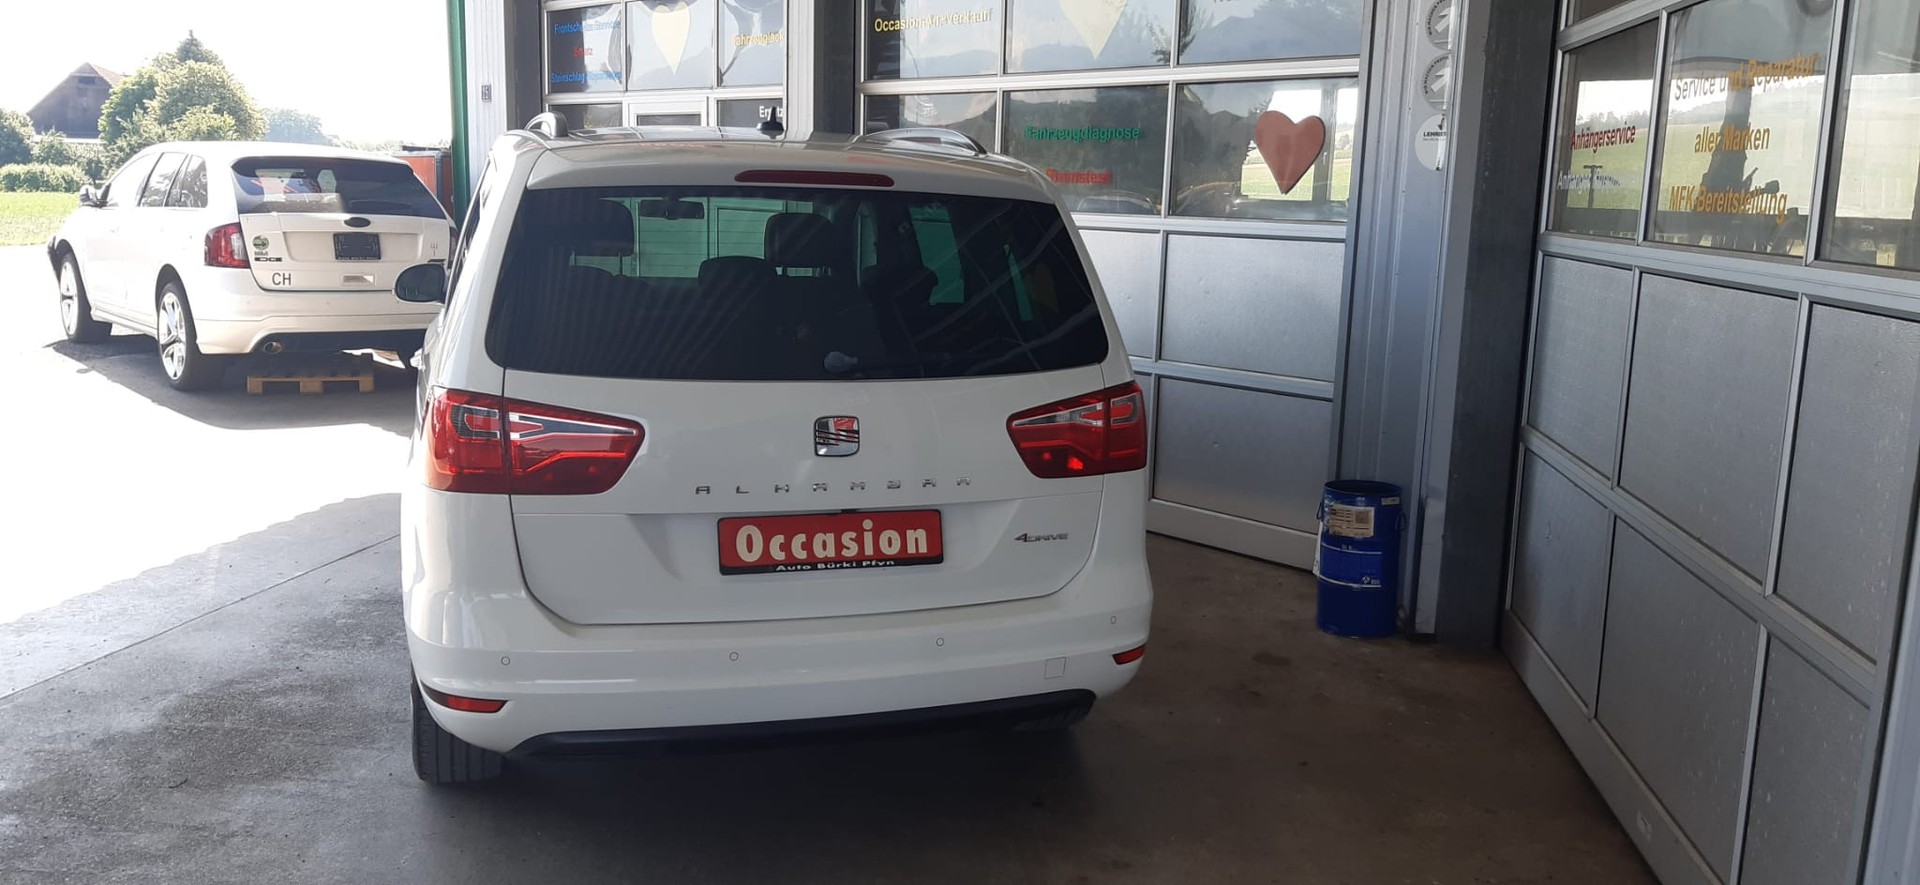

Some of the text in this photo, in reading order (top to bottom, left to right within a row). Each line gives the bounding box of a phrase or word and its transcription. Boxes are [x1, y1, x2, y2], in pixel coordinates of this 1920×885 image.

[1675, 75, 1716, 100] Service
[1748, 53, 1818, 93] Reparatur
[1024, 124, 1140, 143] Fahrzeugdiagnose
[1570, 121, 1636, 153] Anhängerservice
[1695, 122, 1770, 153] aller Marken
[1669, 184, 1788, 224] MFK-Bereitstellung
[272, 272, 291, 285] CH
[695, 476, 971, 495] ALHAMBRA
[736, 519, 928, 563] Occasion
[776, 564, 811, 572] Auto
[817, 561, 857, 569] Bürki
